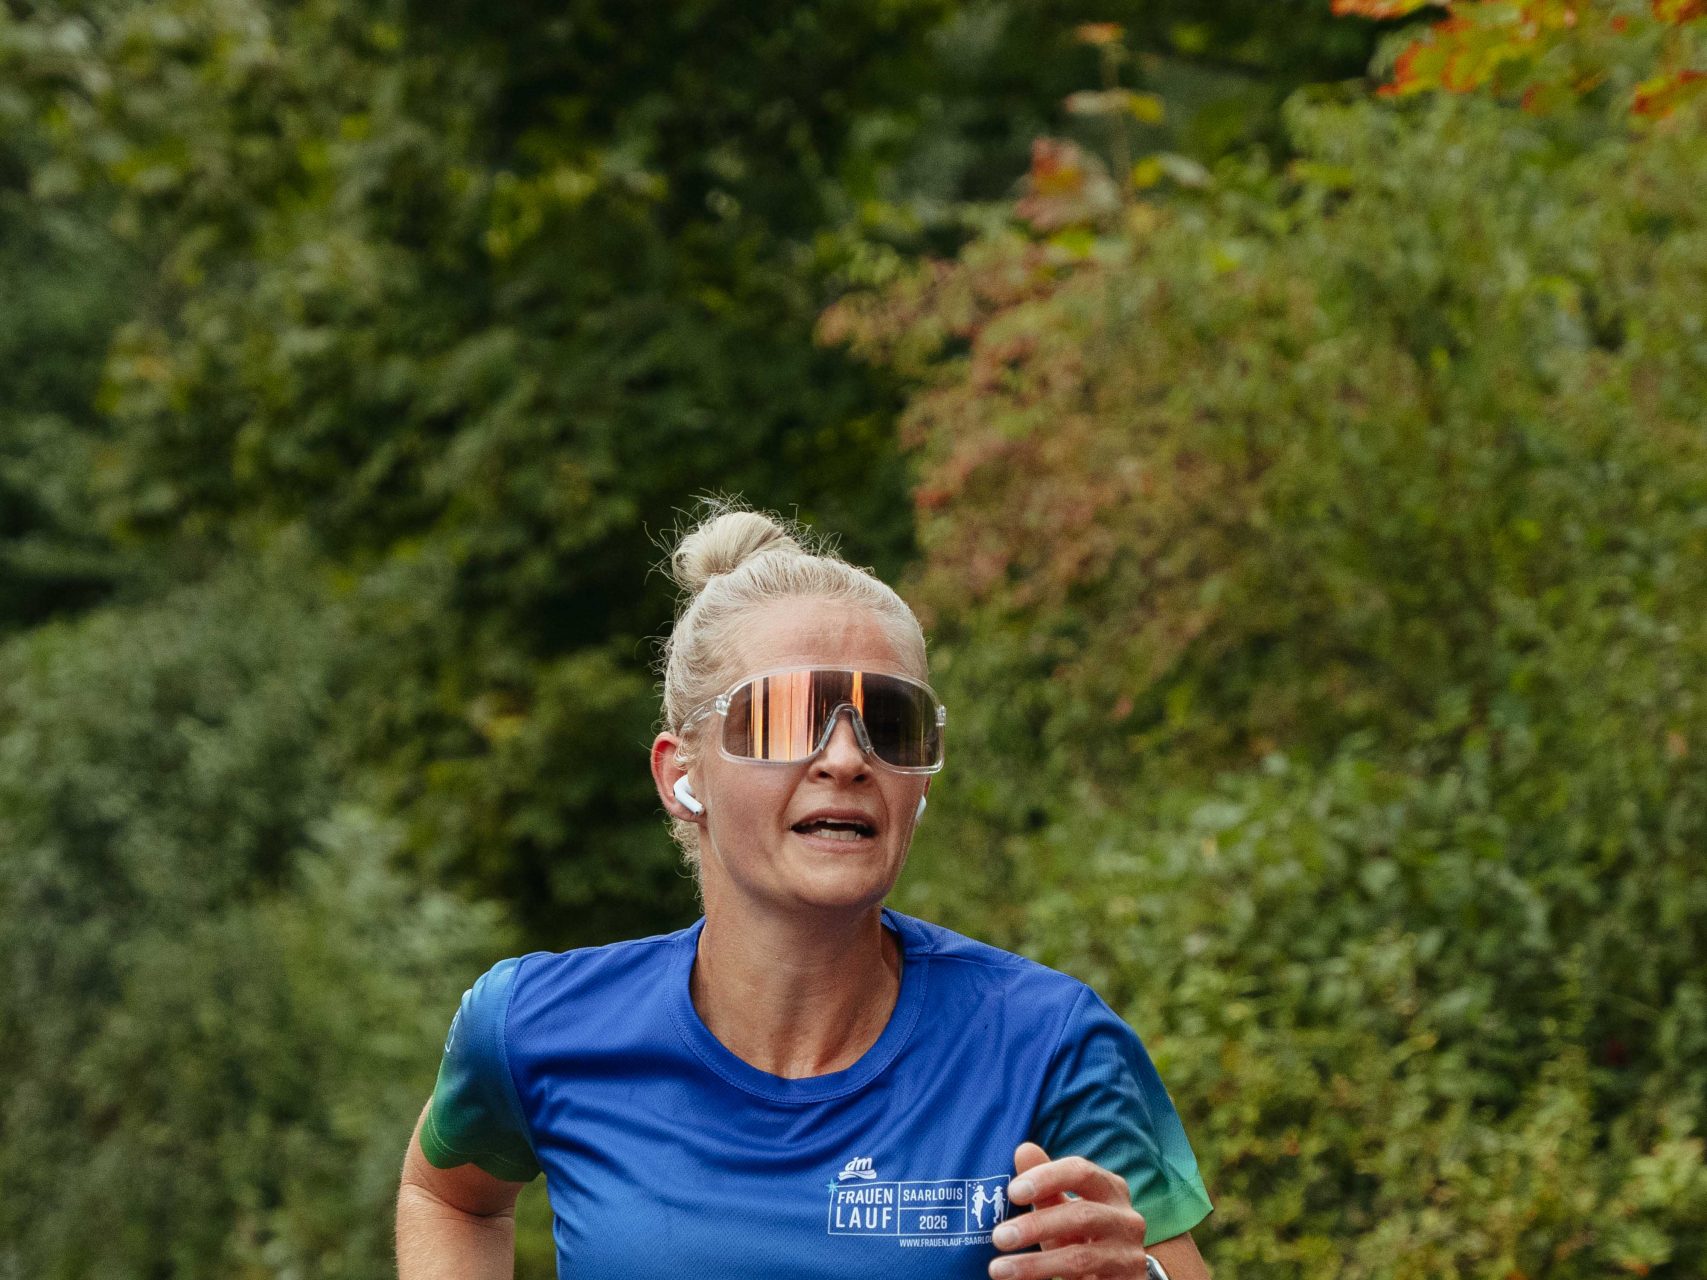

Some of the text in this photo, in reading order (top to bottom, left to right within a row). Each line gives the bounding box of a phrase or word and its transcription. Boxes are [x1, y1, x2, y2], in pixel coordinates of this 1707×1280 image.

[845, 1157, 872, 1171] dm
[837, 1188, 893, 1205] FRAUEN
[903, 1188, 963, 1202] SAARLOUIS
[836, 1207, 893, 1229] LAUF
[919, 1215, 948, 1230] 2026
